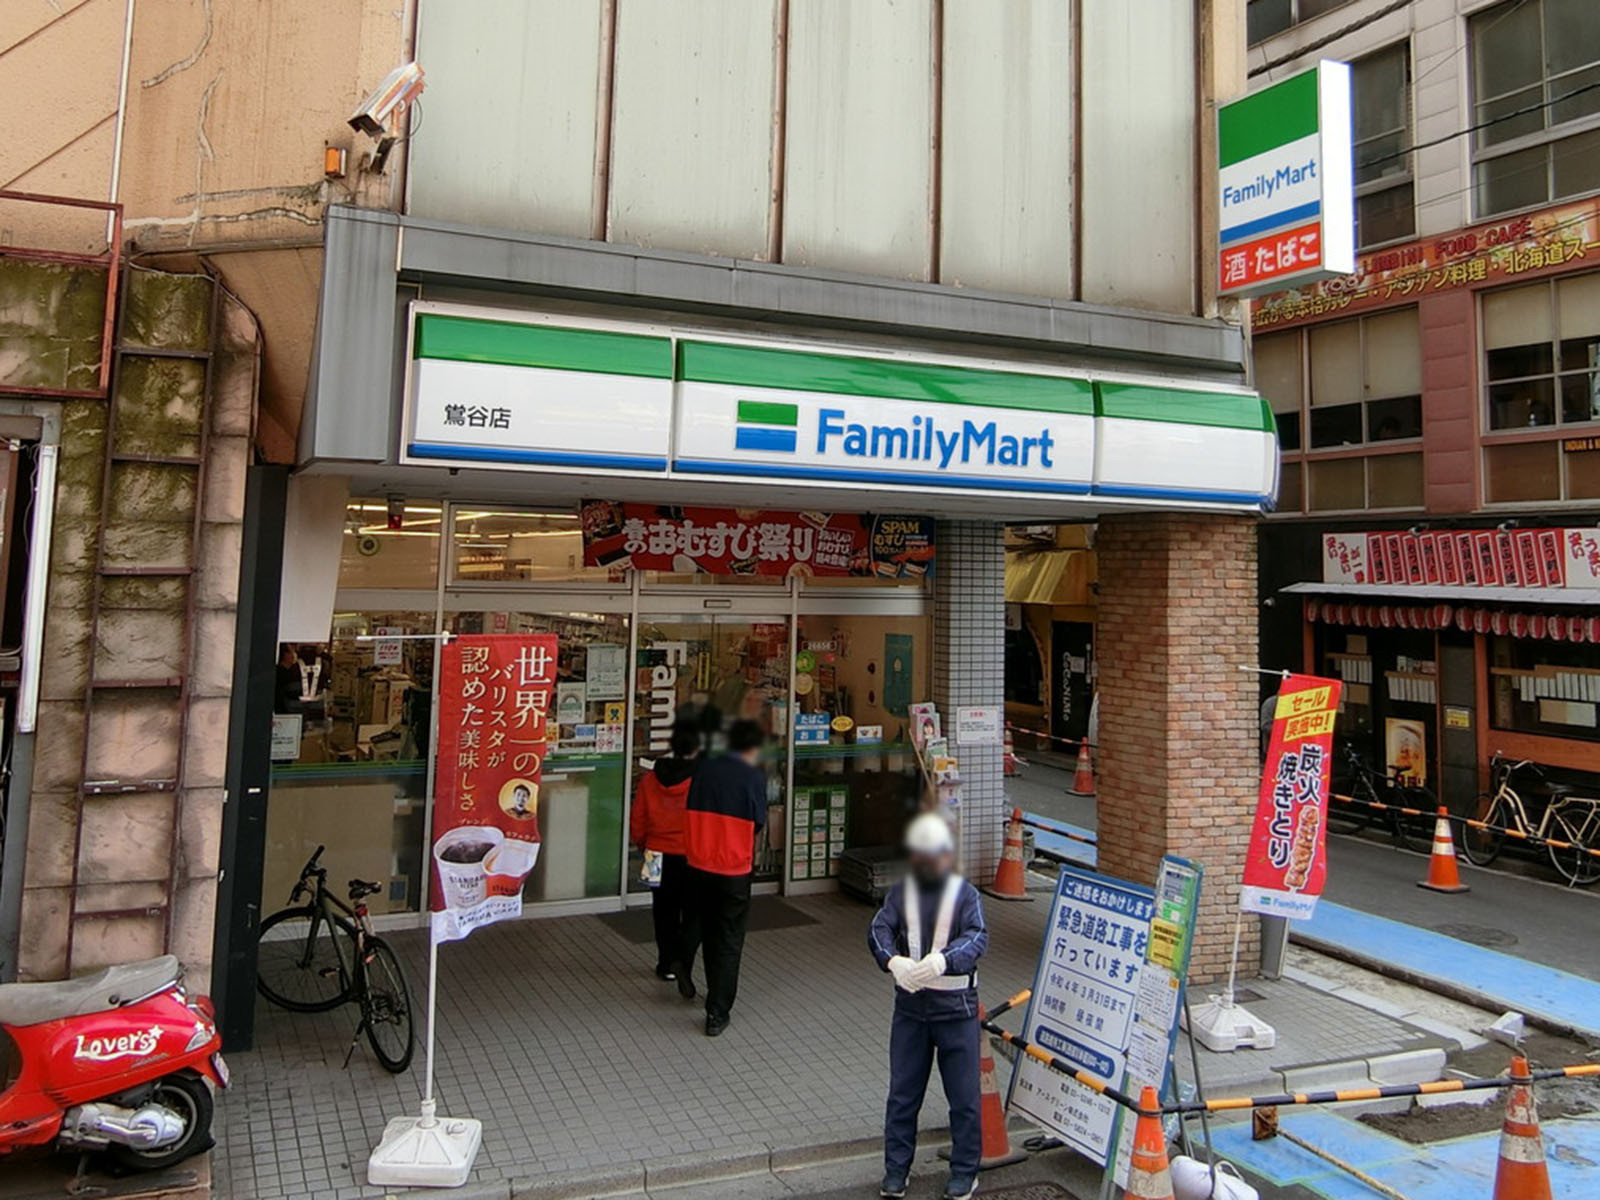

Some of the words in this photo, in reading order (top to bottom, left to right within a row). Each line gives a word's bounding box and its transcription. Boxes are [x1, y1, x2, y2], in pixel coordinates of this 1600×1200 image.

[1223, 159, 1317, 208] FamilyMart
[1434, 233, 1476, 261] FOOD
[818, 408, 1055, 471] FamilyMart
[647, 518, 814, 562] おむすび祭り
[880, 518, 920, 536] SPAM
[487, 664, 515, 769] バリスタが
[509, 645, 553, 776] 世界一の
[1291, 689, 1327, 712] セール
[1299, 744, 1322, 803] 炭火
[1269, 752, 1299, 867] 焼きとり
[1057, 904, 1148, 958] 緊急道路工事を
[1053, 936, 1139, 984] 行っています
